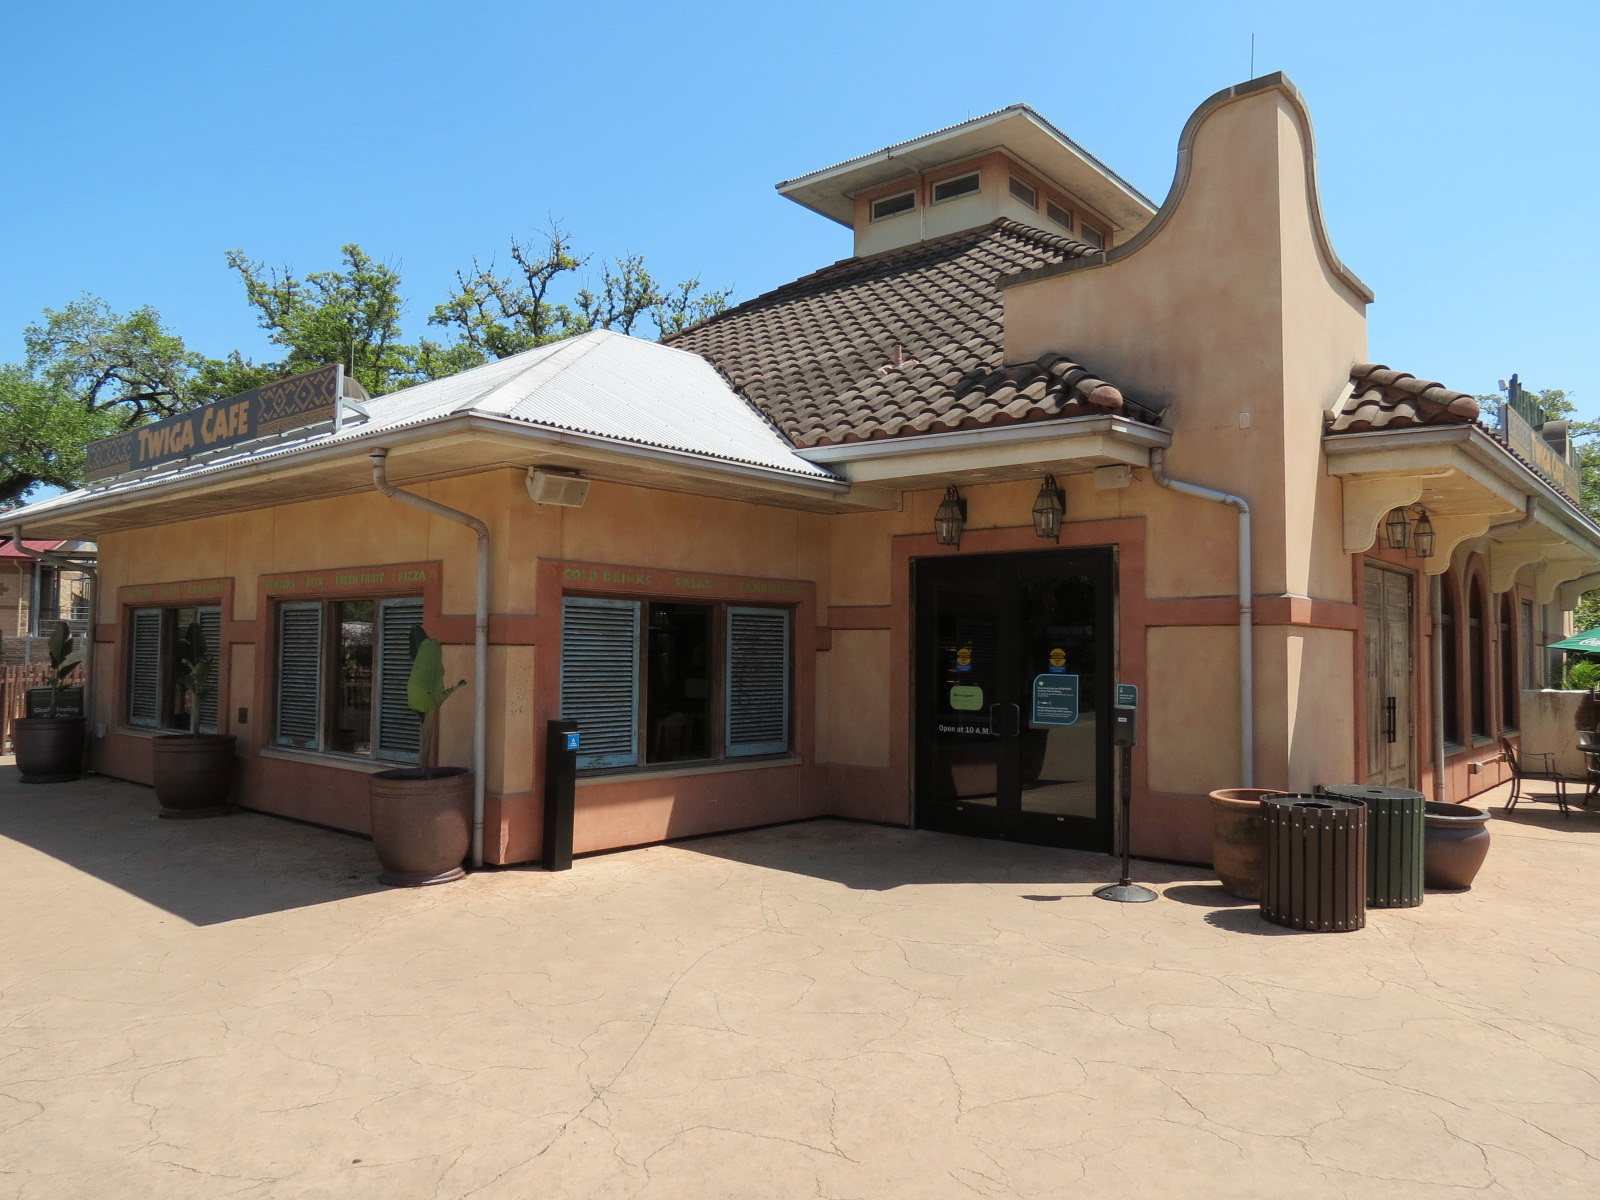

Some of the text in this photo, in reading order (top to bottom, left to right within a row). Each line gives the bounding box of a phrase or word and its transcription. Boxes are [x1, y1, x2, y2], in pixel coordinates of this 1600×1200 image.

[138, 401, 250, 461] TWIGA CAFE
[335, 572, 385, 586] FRESH FRUIT
[398, 570, 426, 583] PIZZA
[562, 567, 652, 585] COLD DRINKS
[938, 724, 956, 733] Open
[965, 726, 975, 734] 10
[975, 727, 991, 735] A.M.
